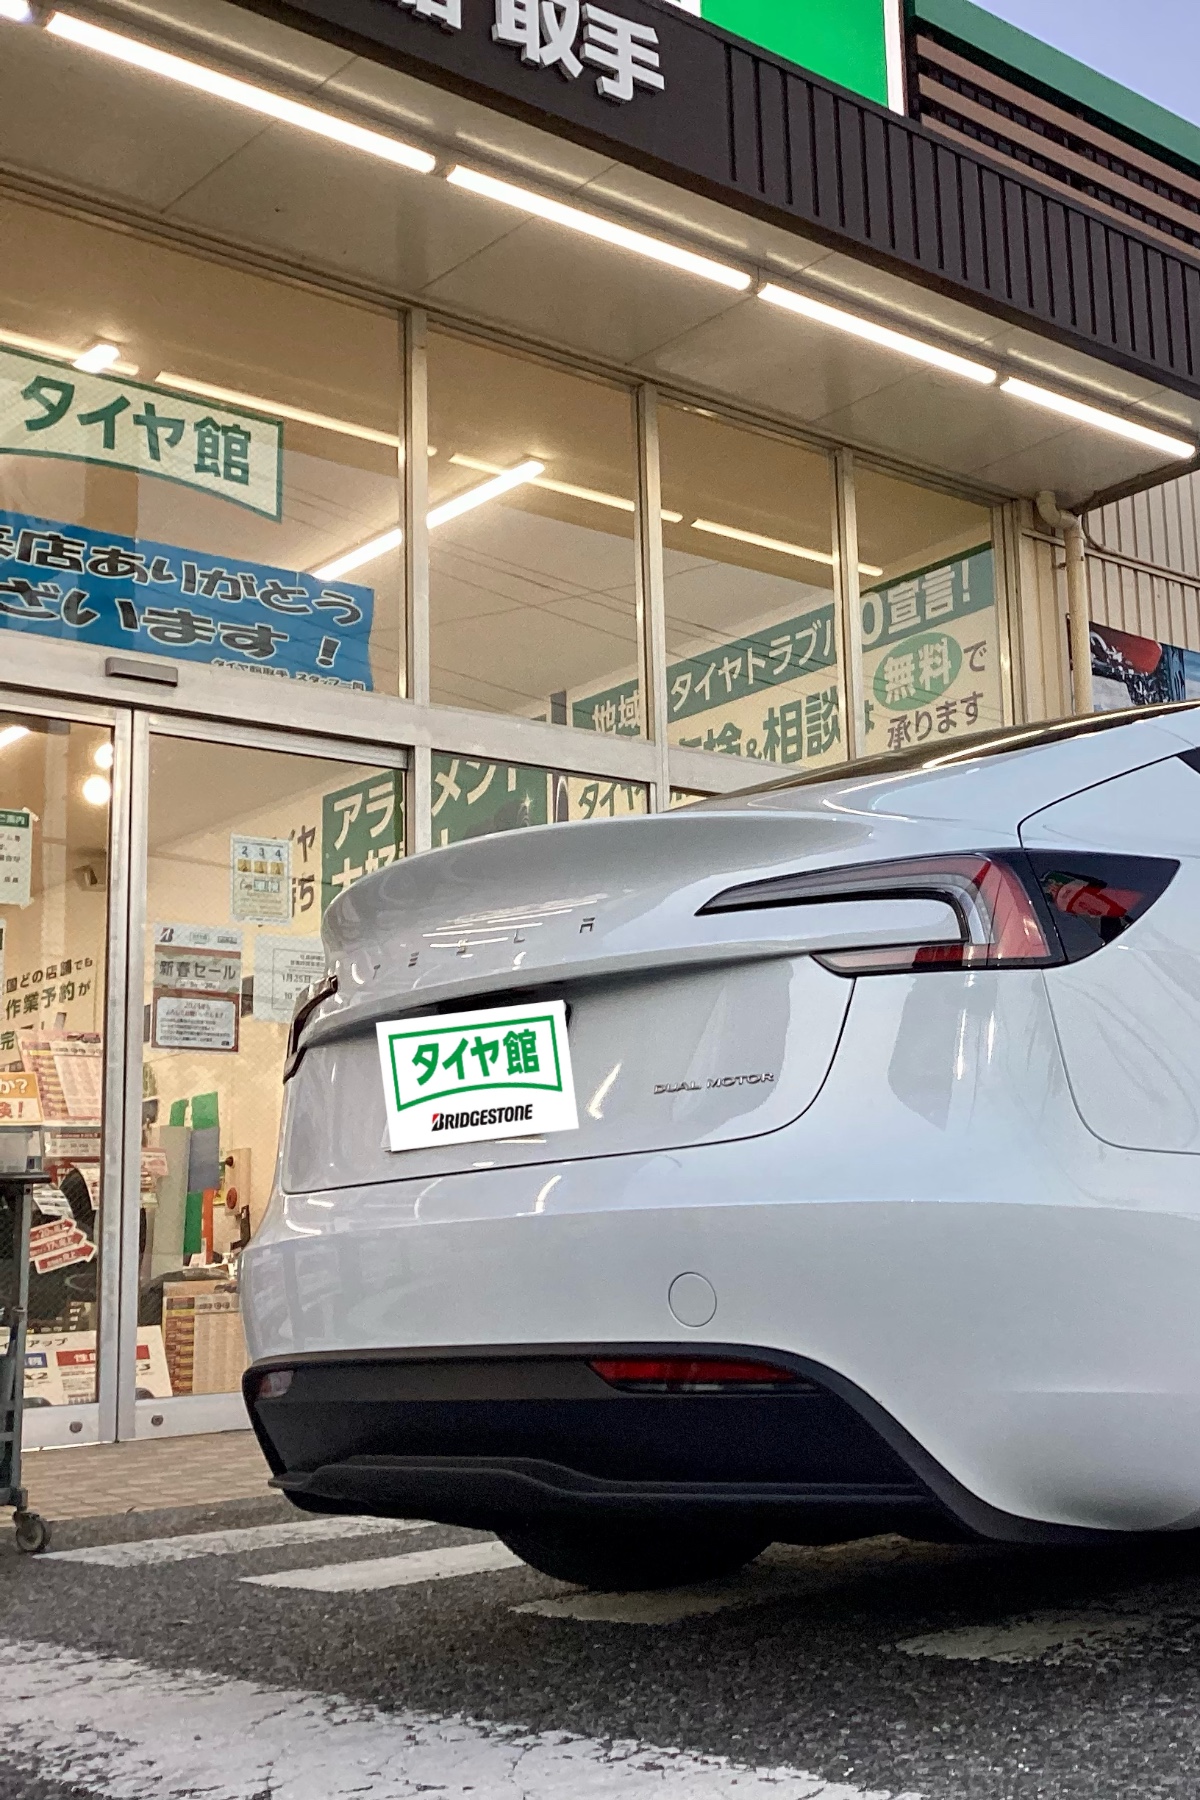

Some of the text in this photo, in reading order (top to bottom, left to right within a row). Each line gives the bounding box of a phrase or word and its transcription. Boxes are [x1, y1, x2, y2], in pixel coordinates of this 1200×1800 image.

[492, 0, 665, 101] 取手
[20, 375, 252, 486] タイヤ館
[0, 524, 364, 627] 店ありがとう
[887, 690, 984, 750] 承ります
[5, 980, 91, 1020] 作業予約が
[159, 960, 236, 980] 新春セール
[653, 1072, 775, 1094] DUAL MOTOR
